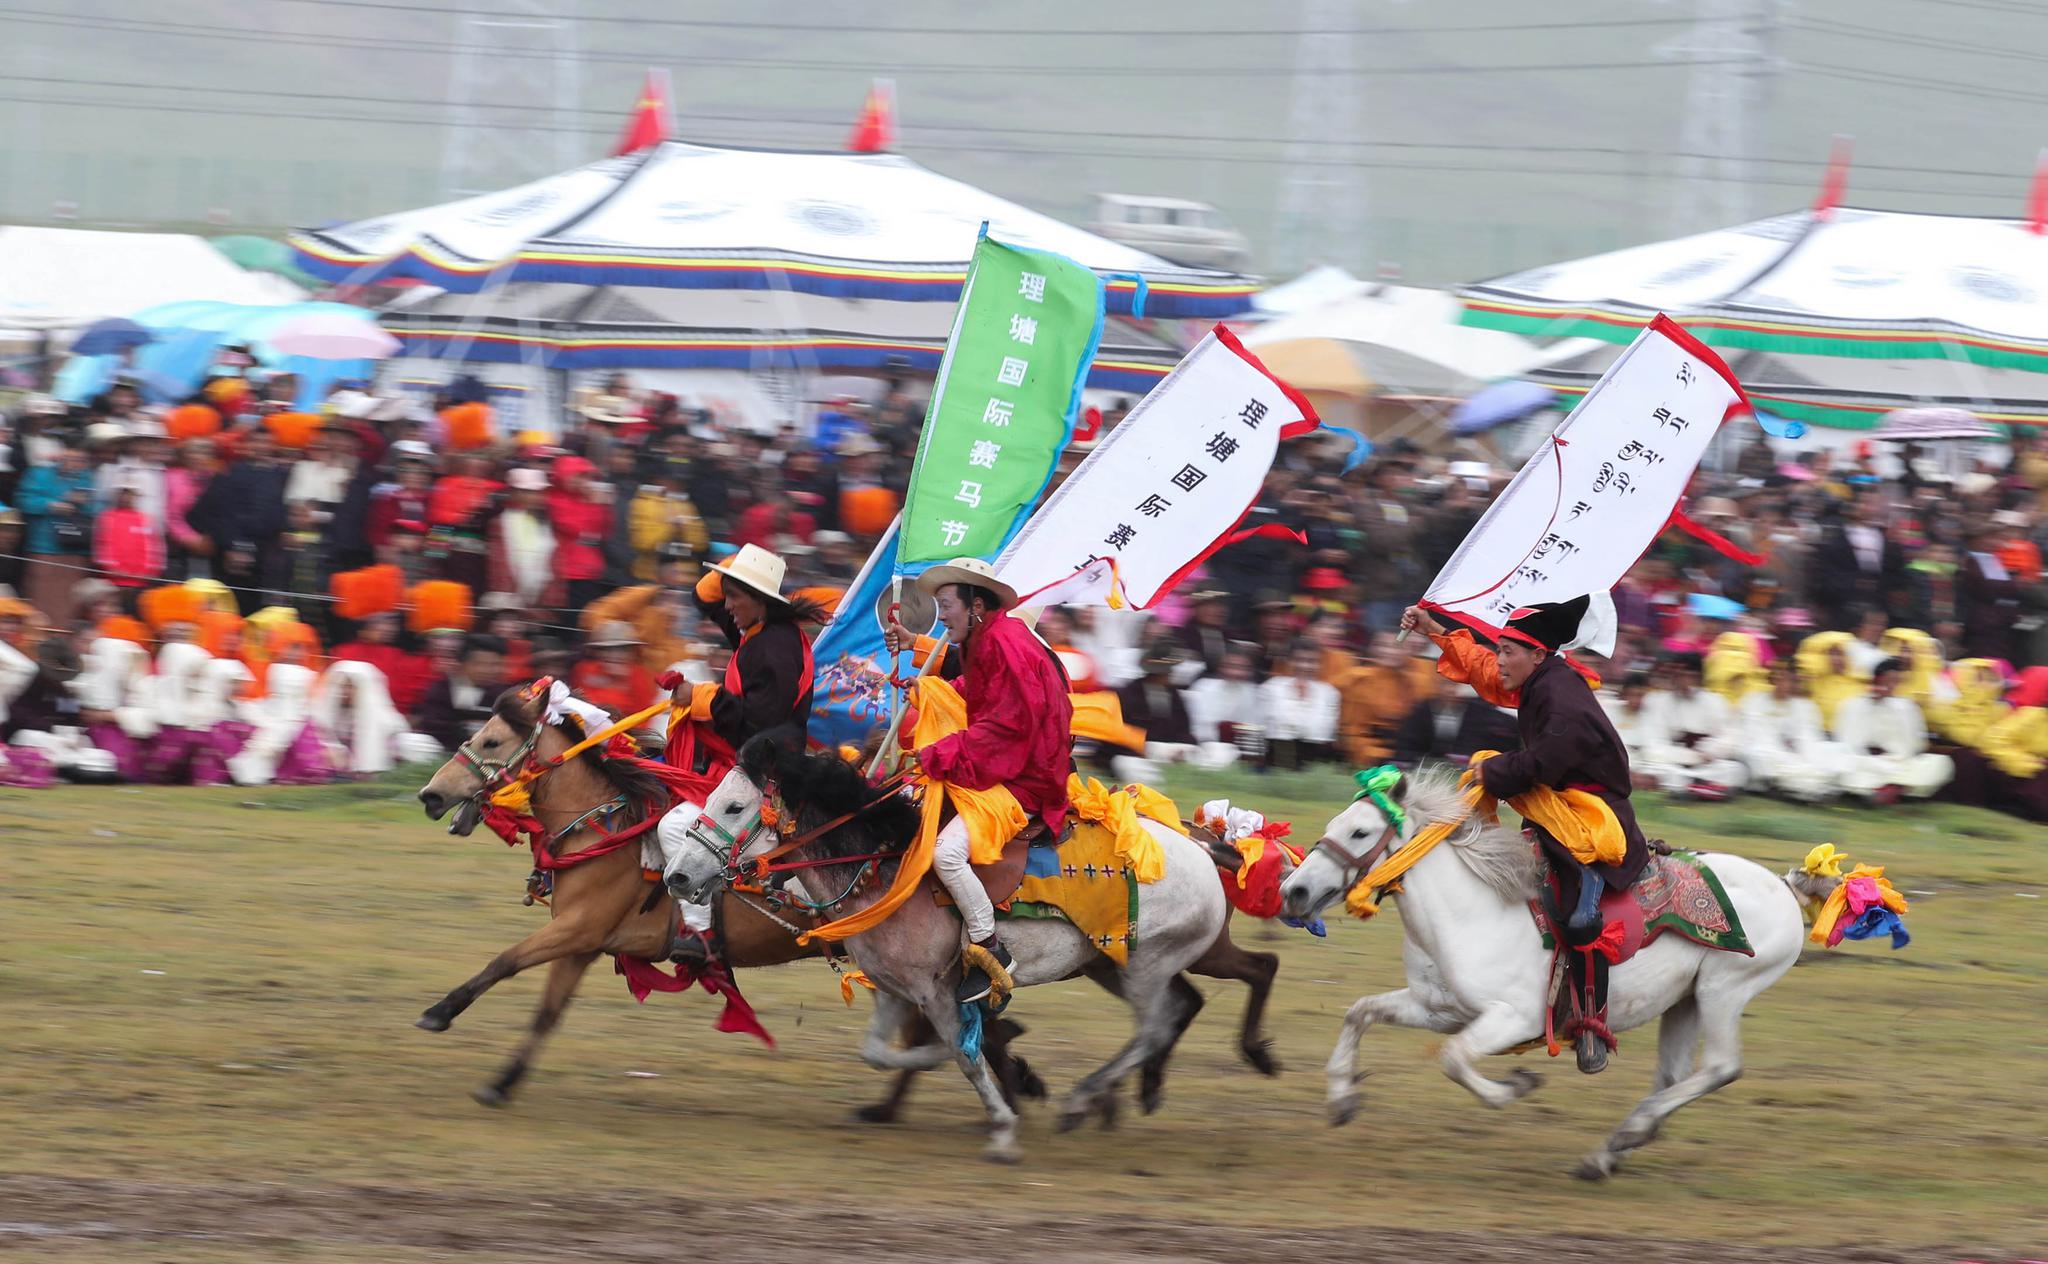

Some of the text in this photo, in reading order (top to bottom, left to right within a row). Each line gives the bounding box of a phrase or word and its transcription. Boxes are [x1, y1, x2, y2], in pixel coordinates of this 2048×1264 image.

[940, 271, 1047, 547] 理塘国际赛马节
